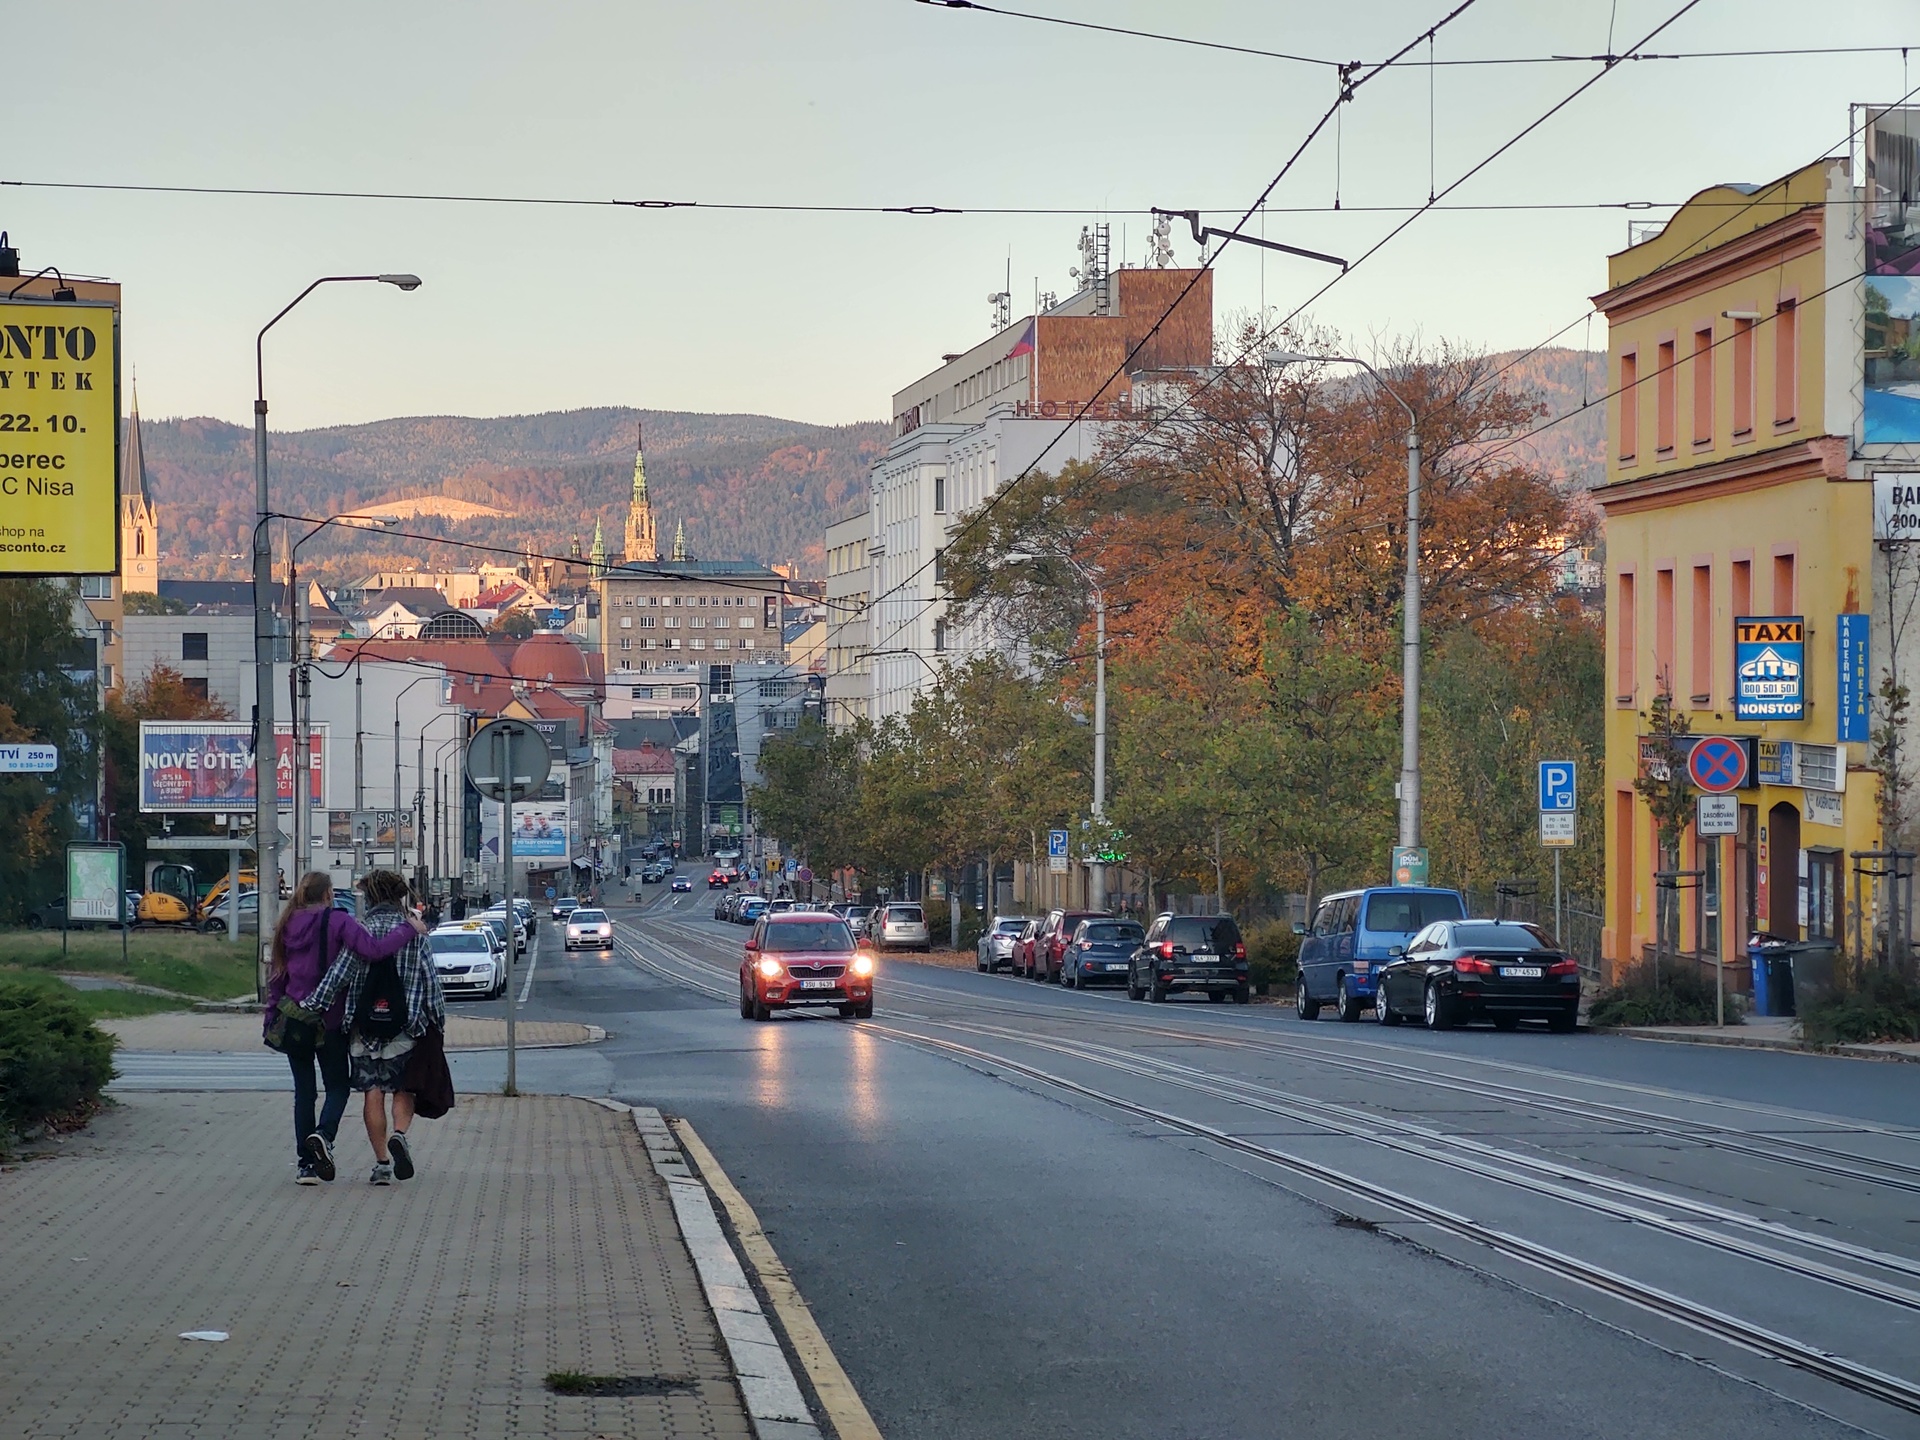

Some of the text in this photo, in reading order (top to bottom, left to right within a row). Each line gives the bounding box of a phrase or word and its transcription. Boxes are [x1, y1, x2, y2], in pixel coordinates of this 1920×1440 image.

[0, 326, 96, 361] NTO
[1016, 399, 1108, 419] HOTE
[0, 414, 87, 433] 22. 10.
[26, 477, 74, 496] Nisa
[1892, 486, 1920, 505] BA
[1892, 513, 1920, 529] 200
[0, 525, 45, 538] hop na
[0, 542, 66, 553] sconto.cz
[1738, 624, 1802, 642] TAXI
[1741, 661, 1798, 676] CITY
[1857, 641, 1865, 715] TEREZA
[1744, 684, 1795, 693] 800 501 501
[1738, 703, 1803, 715] NONSTOP
[28, 752, 43, 760] 250
[145, 747, 199, 769] NOVĚ
[1760, 743, 1780, 756] TAXI
[1547, 768, 1568, 797] P
